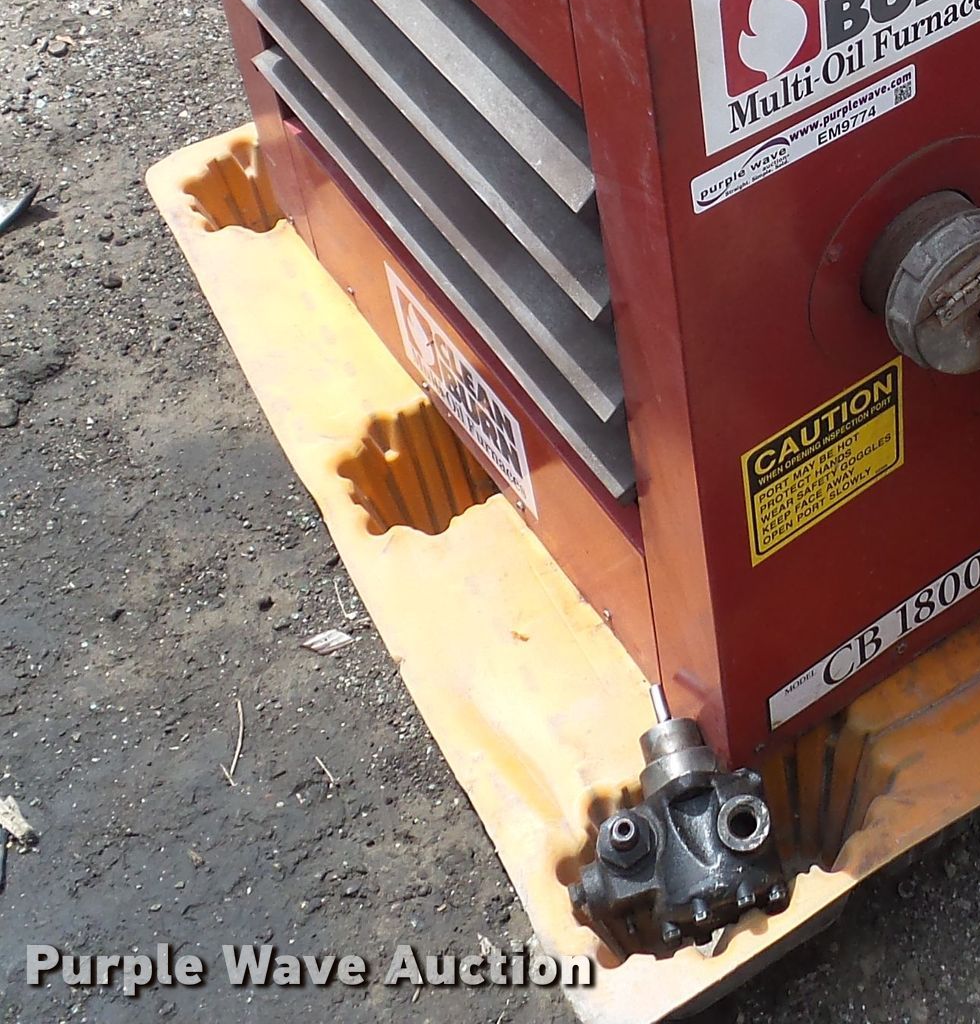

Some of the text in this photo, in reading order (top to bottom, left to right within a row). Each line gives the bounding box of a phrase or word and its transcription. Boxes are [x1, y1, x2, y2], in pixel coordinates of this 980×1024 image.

[728, 40, 863, 134] Multi-Oil
[789, 71, 912, 142] www.purplewave.com
[817, 105, 876, 145] EM9774
[700, 147, 787, 200] purple wave
[434, 331, 518, 449] CLEAN
[439, 355, 525, 480] BURN
[754, 373, 892, 476] CAUTION
[758, 396, 892, 486] WHEN OPENING INSPECTION PORT
[759, 433, 860, 503] PORT MAY BE HOT
[760, 433, 892, 524] WEAR SAFETY GOGGLES
[760, 449, 852, 514] PROTECT HANDS
[762, 468, 855, 535] KEEP FACE AWAY
[763, 467, 871, 545] OPEN PORT SLOWLY
[784, 669, 817, 696] MODEL
[822, 625, 882, 686] CB
